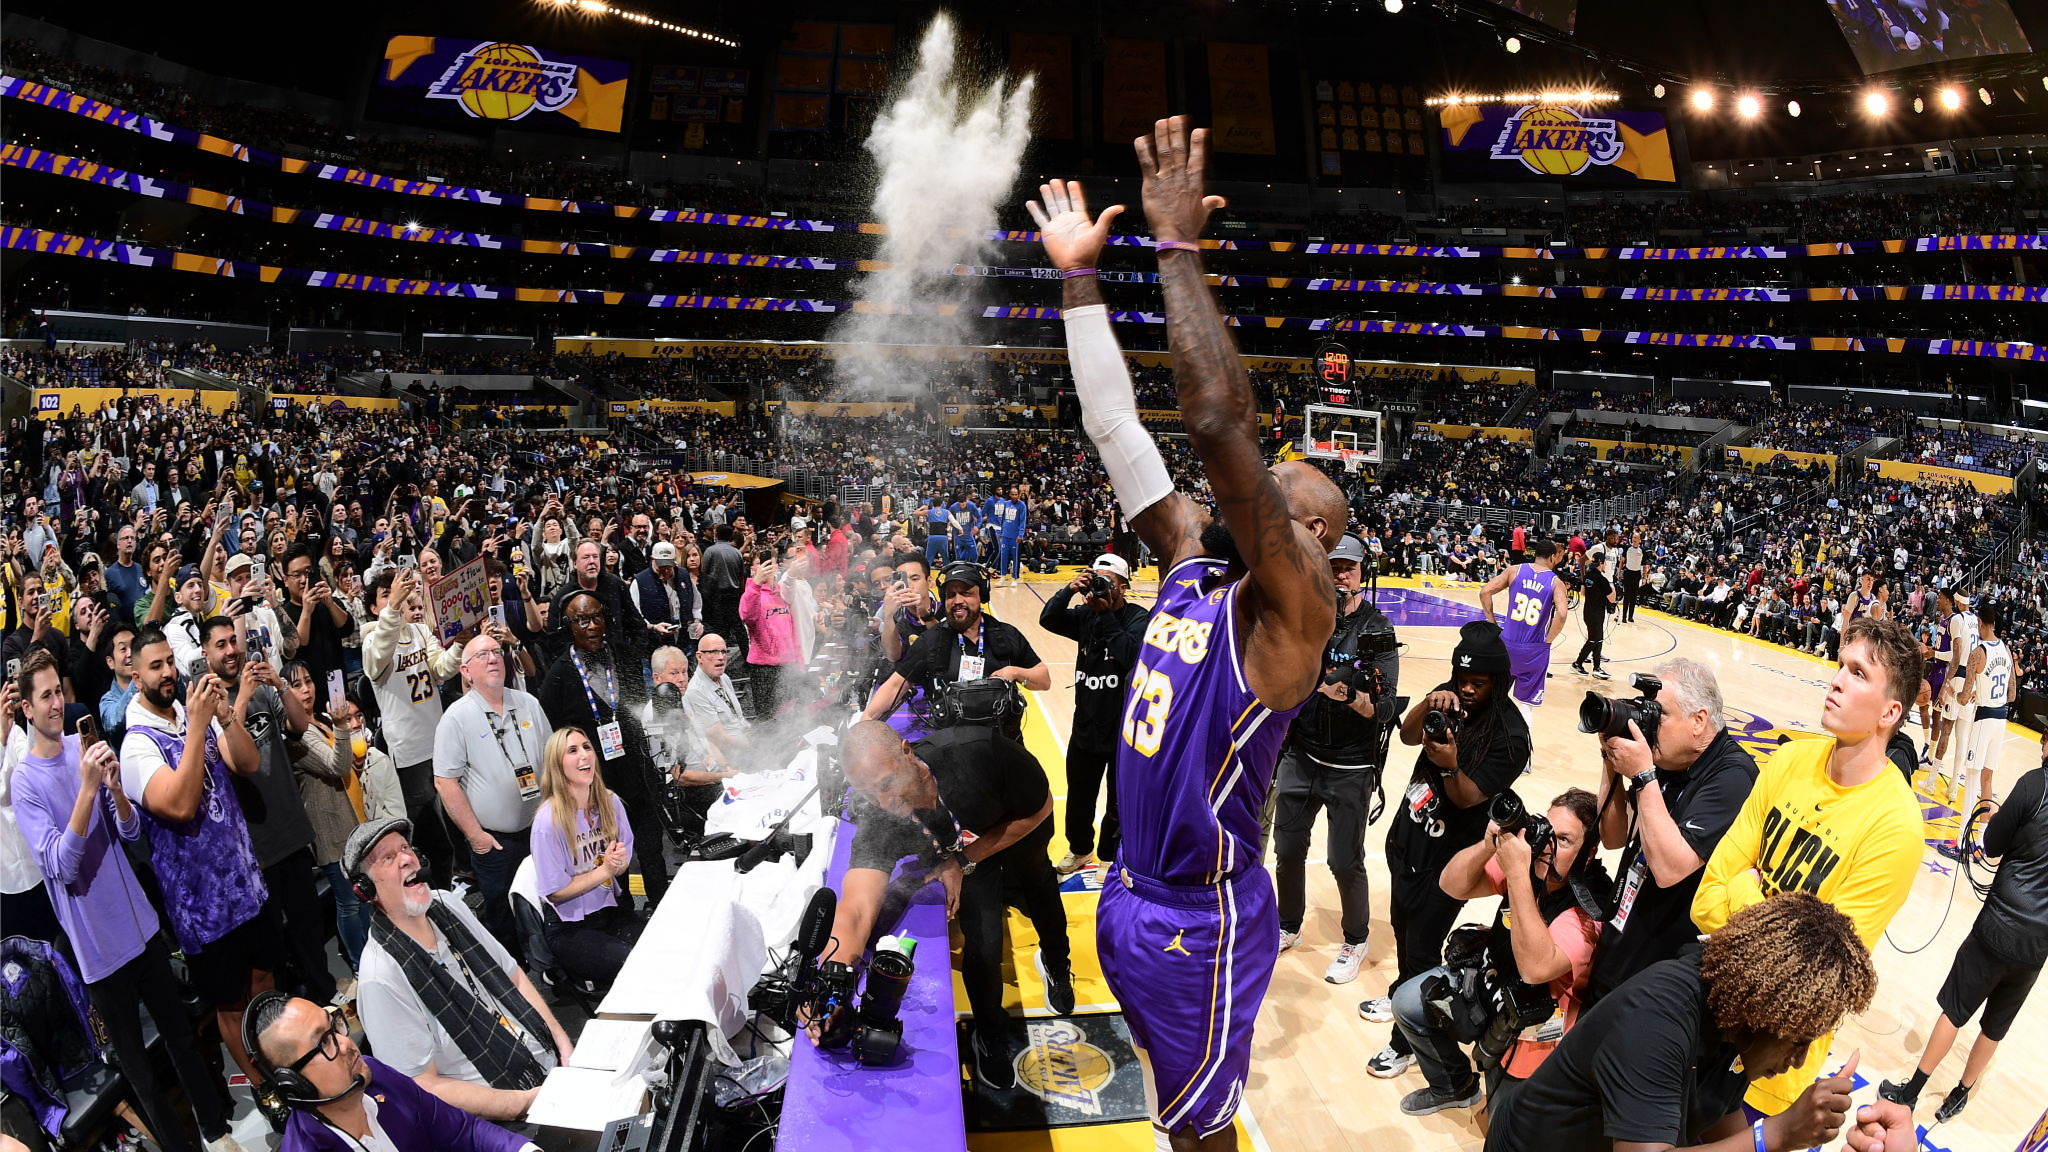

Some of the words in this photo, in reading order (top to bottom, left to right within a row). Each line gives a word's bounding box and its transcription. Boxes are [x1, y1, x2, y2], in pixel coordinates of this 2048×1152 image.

[484, 57, 508, 65] LOS
[509, 60, 572, 74] ANGELES
[43, 76, 72, 91] Spectrum
[439, 55, 571, 108] LAKERS
[1500, 119, 1622, 163] LAKERS
[1004, 269, 1025, 277] Lakers
[1034, 269, 1063, 279] 12:00
[1117, 272, 1124, 282] 0
[652, 346, 684, 355] LOS
[1325, 352, 1348, 364] 12:00
[1262, 361, 1293, 370] LOS
[1369, 366, 1435, 378] LAKERS
[1324, 361, 1346, 381] 24
[1328, 387, 1351, 395] TISSOT
[41, 396, 58, 409] 102
[273, 399, 287, 408] 103
[612, 404, 626, 412] 105
[652, 458, 673, 466] ULTRA
[460, 571, 466, 583] I
[466, 566, 482, 580] flew
[1522, 578, 1545, 593] SMART
[50, 596, 63, 613] 23
[441, 591, 463, 615] 8000
[463, 581, 477, 592] miles
[1511, 592, 1543, 626] 36
[439, 615, 449, 625] see
[395, 648, 429, 672] LAKER
[1984, 656, 2007, 677] WASHINGTON
[406, 670, 433, 704] 23
[1075, 670, 1119, 690] POTO
[1990, 673, 2007, 699] 25
[1122, 659, 1174, 758] 23
[1825, 828, 1839, 843] BY
[1612, 878, 1625, 903] Canon
[1032, 1028, 1046, 1065] ANGELES
[1038, 1066, 1050, 1083] LOS
[1043, 1027, 1095, 1110] LAKERS
